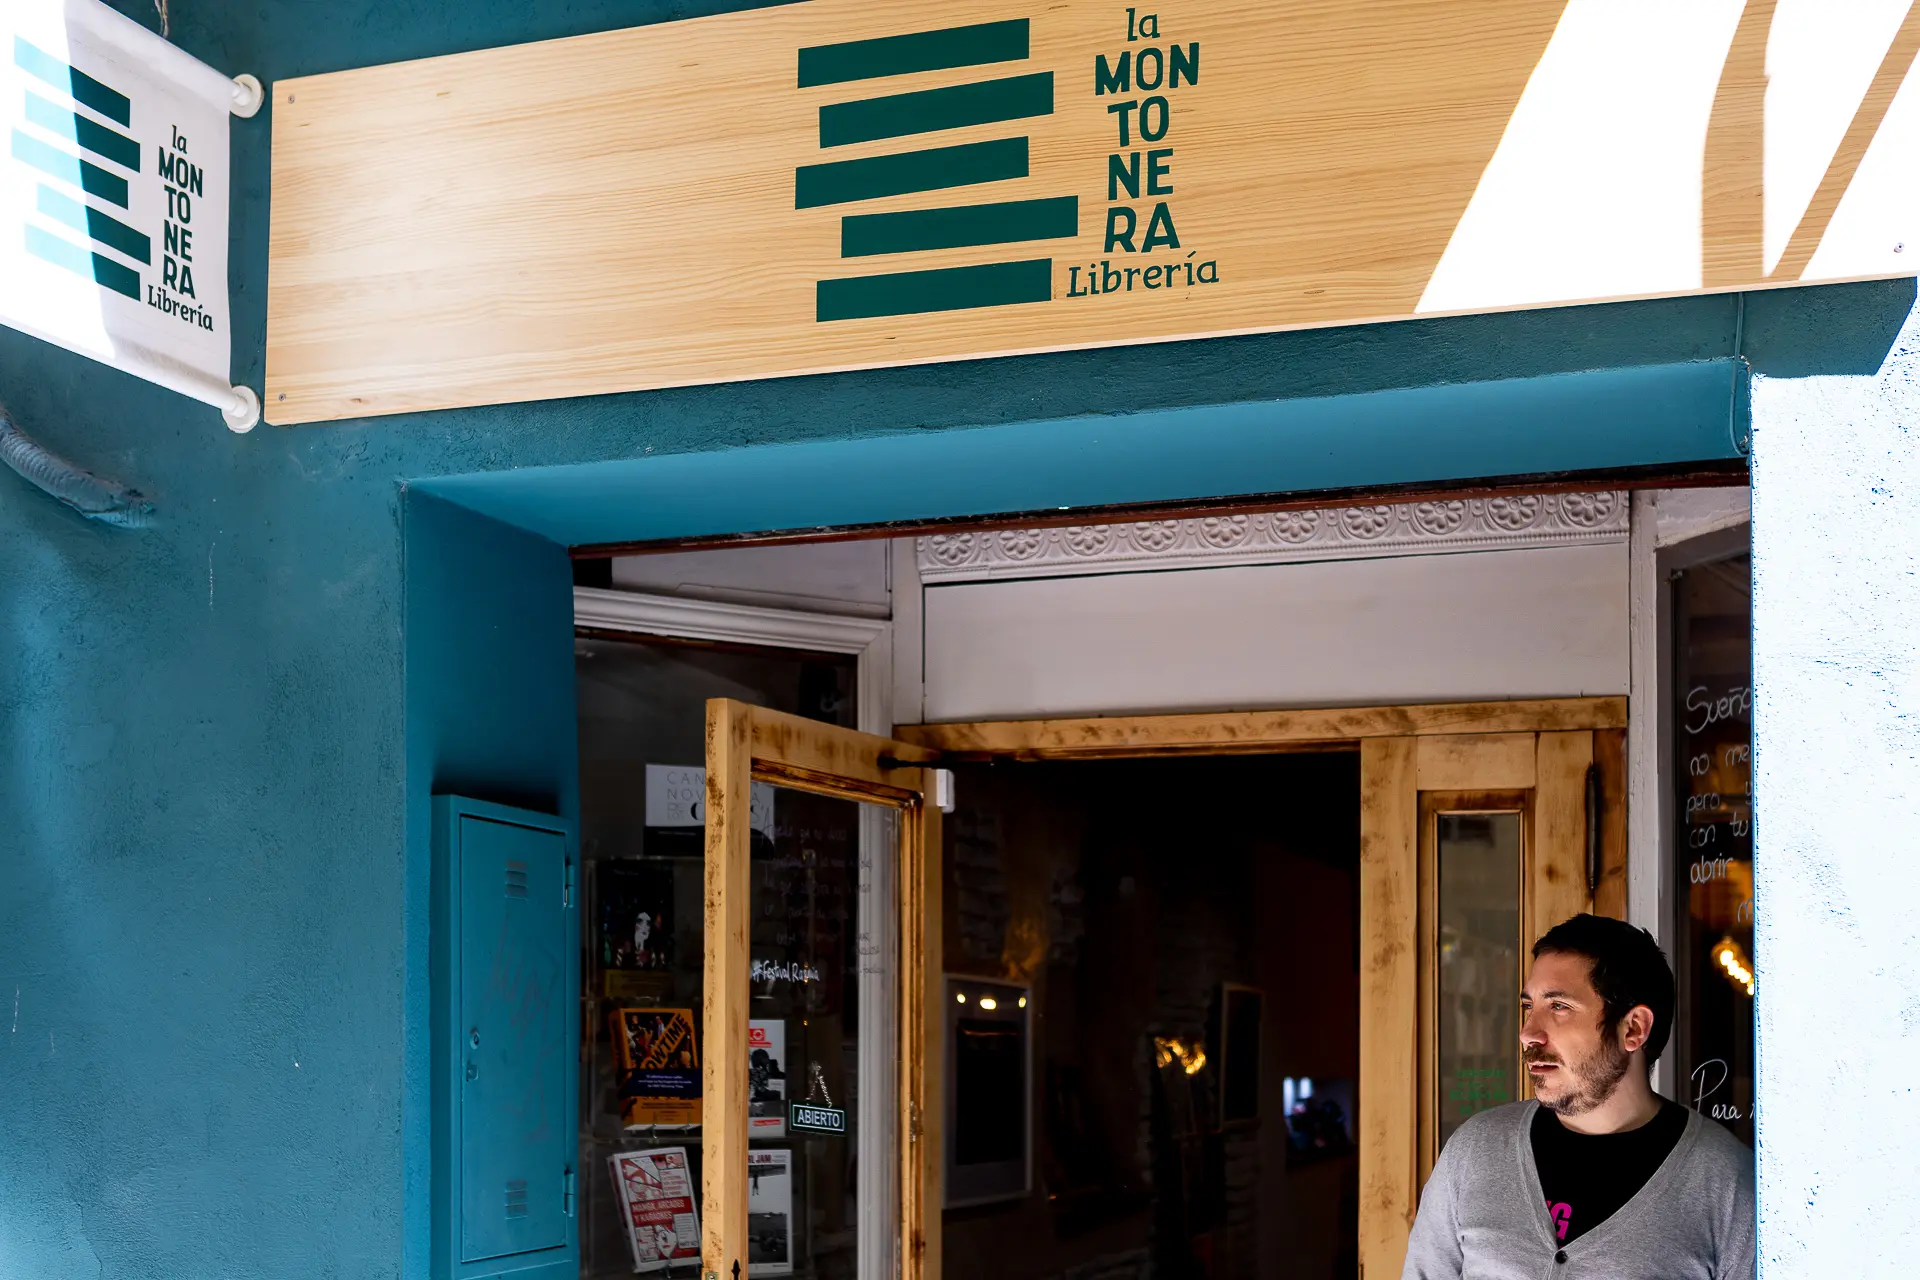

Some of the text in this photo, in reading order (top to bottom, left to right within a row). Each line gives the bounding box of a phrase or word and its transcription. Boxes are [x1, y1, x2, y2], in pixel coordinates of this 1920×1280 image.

[1125, 8, 1161, 42] la
[1095, 42, 1200, 96] MON
[172, 124, 188, 154] la
[1107, 95, 1170, 147] TO
[158, 145, 204, 198] MON
[1108, 147, 1174, 200] NE
[163, 184, 191, 224] TO
[163, 219, 193, 262] NE
[1103, 201, 1181, 253] RA
[162, 253, 196, 300] RA
[1066, 250, 1220, 298] Librería
[147, 284, 214, 332] Librería
[667, 771, 705, 785] CAN
[1690, 754, 1709, 776] no
[666, 788, 705, 801] NOV
[1686, 792, 1720, 824] pero
[1690, 824, 1716, 848] con
[1690, 853, 1734, 884] abrir
[1691, 1058, 1742, 1120] Para
[797, 1109, 840, 1127] ABIERTO
